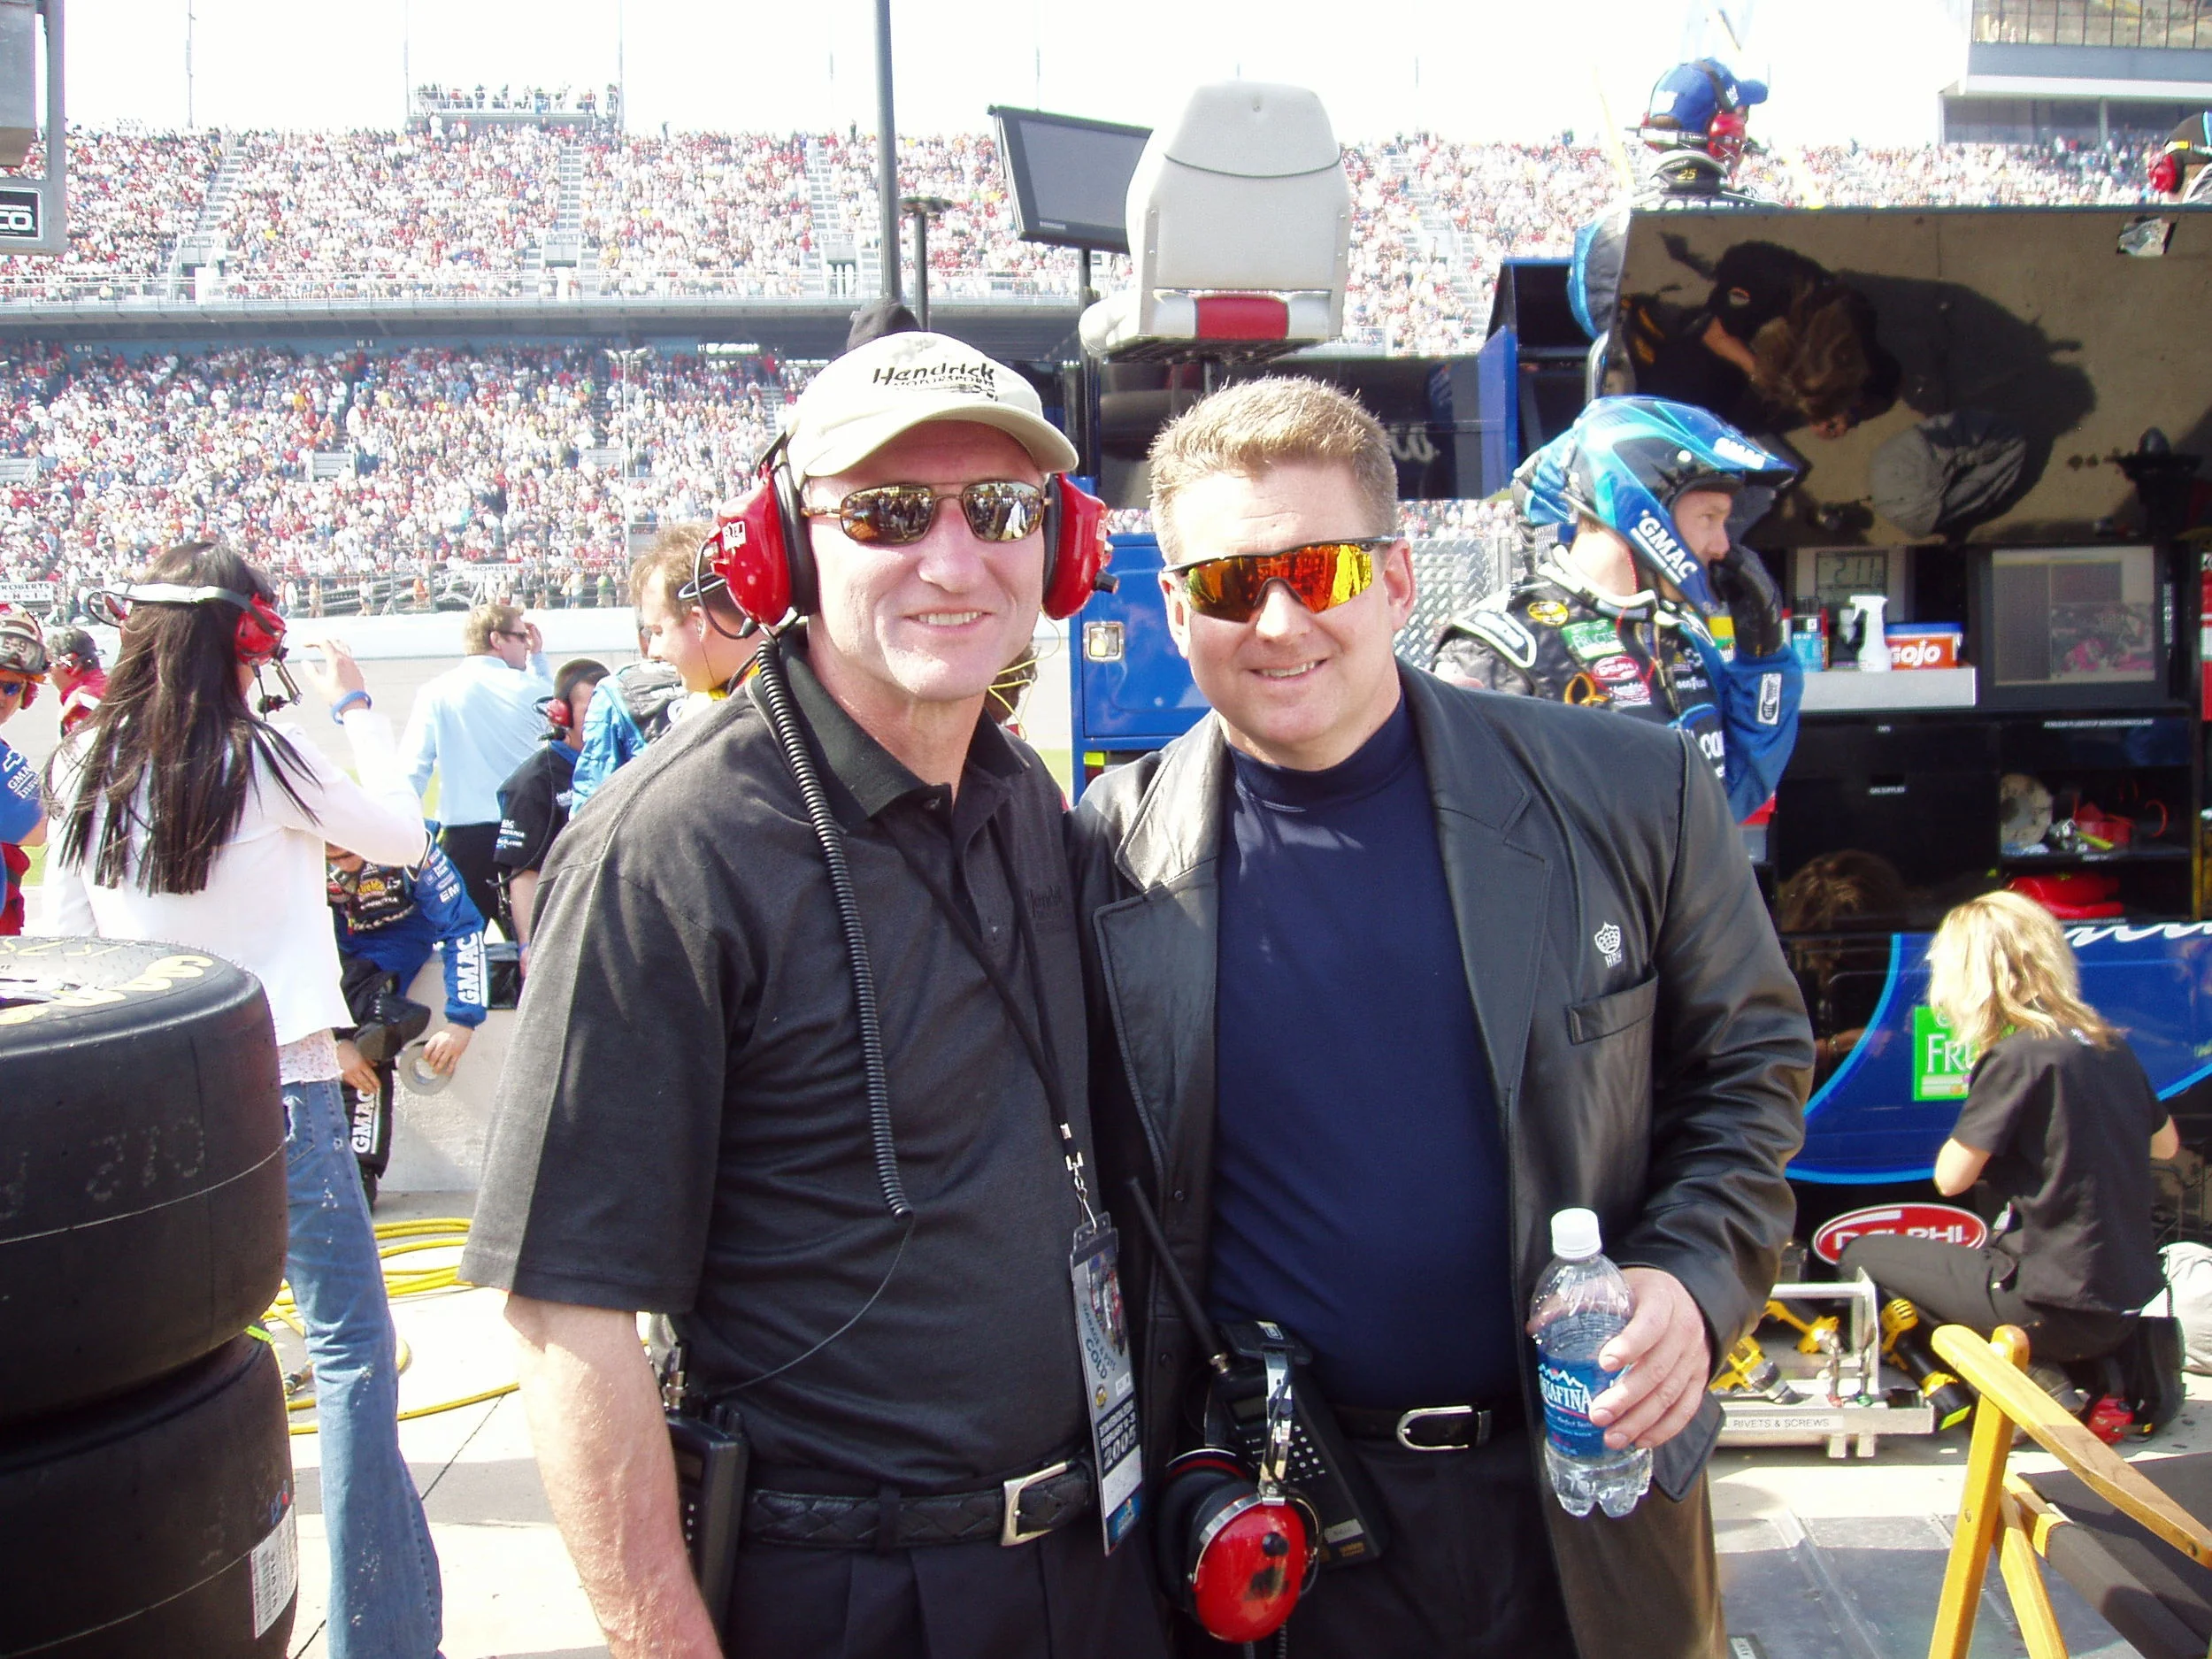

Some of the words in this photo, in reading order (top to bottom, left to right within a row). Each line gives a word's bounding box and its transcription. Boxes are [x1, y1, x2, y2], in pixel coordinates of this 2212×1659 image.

[872, 363, 995, 385] Hendrick
[1639, 517, 1699, 579] GMAC
[457, 932, 480, 1004] GMAC
[1085, 1337, 1108, 1379] COLD
[1733, 1418, 1770, 1428] RIVETS
[1785, 1418, 1830, 1427] SCREWS
[1103, 1423, 1136, 1471] 2005
